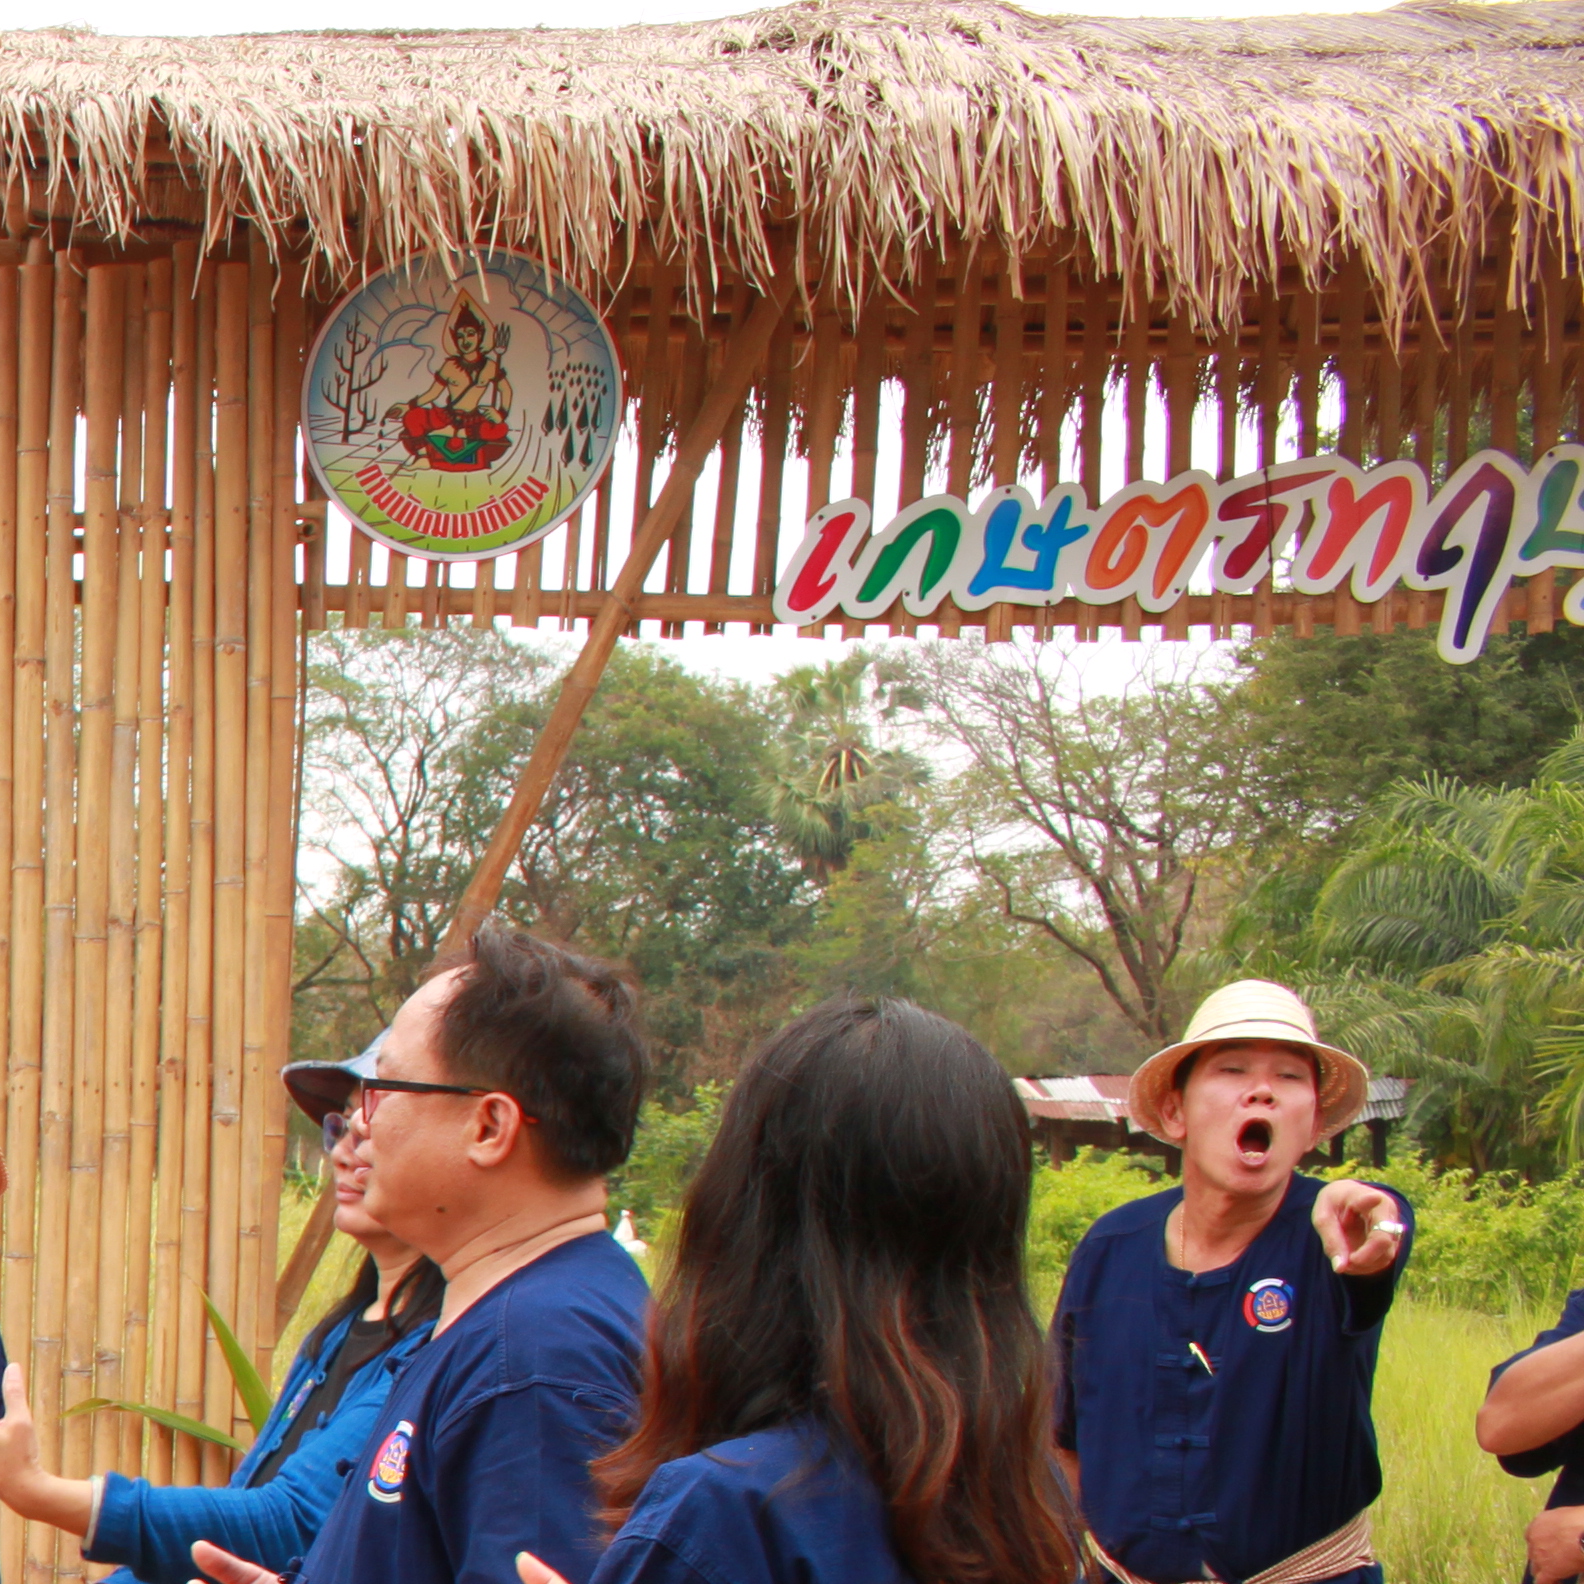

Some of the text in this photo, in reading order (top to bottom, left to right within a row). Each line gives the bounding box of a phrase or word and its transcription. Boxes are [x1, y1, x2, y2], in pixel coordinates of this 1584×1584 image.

[354, 463, 551, 539] กรมพัฒนาที่ดิน
